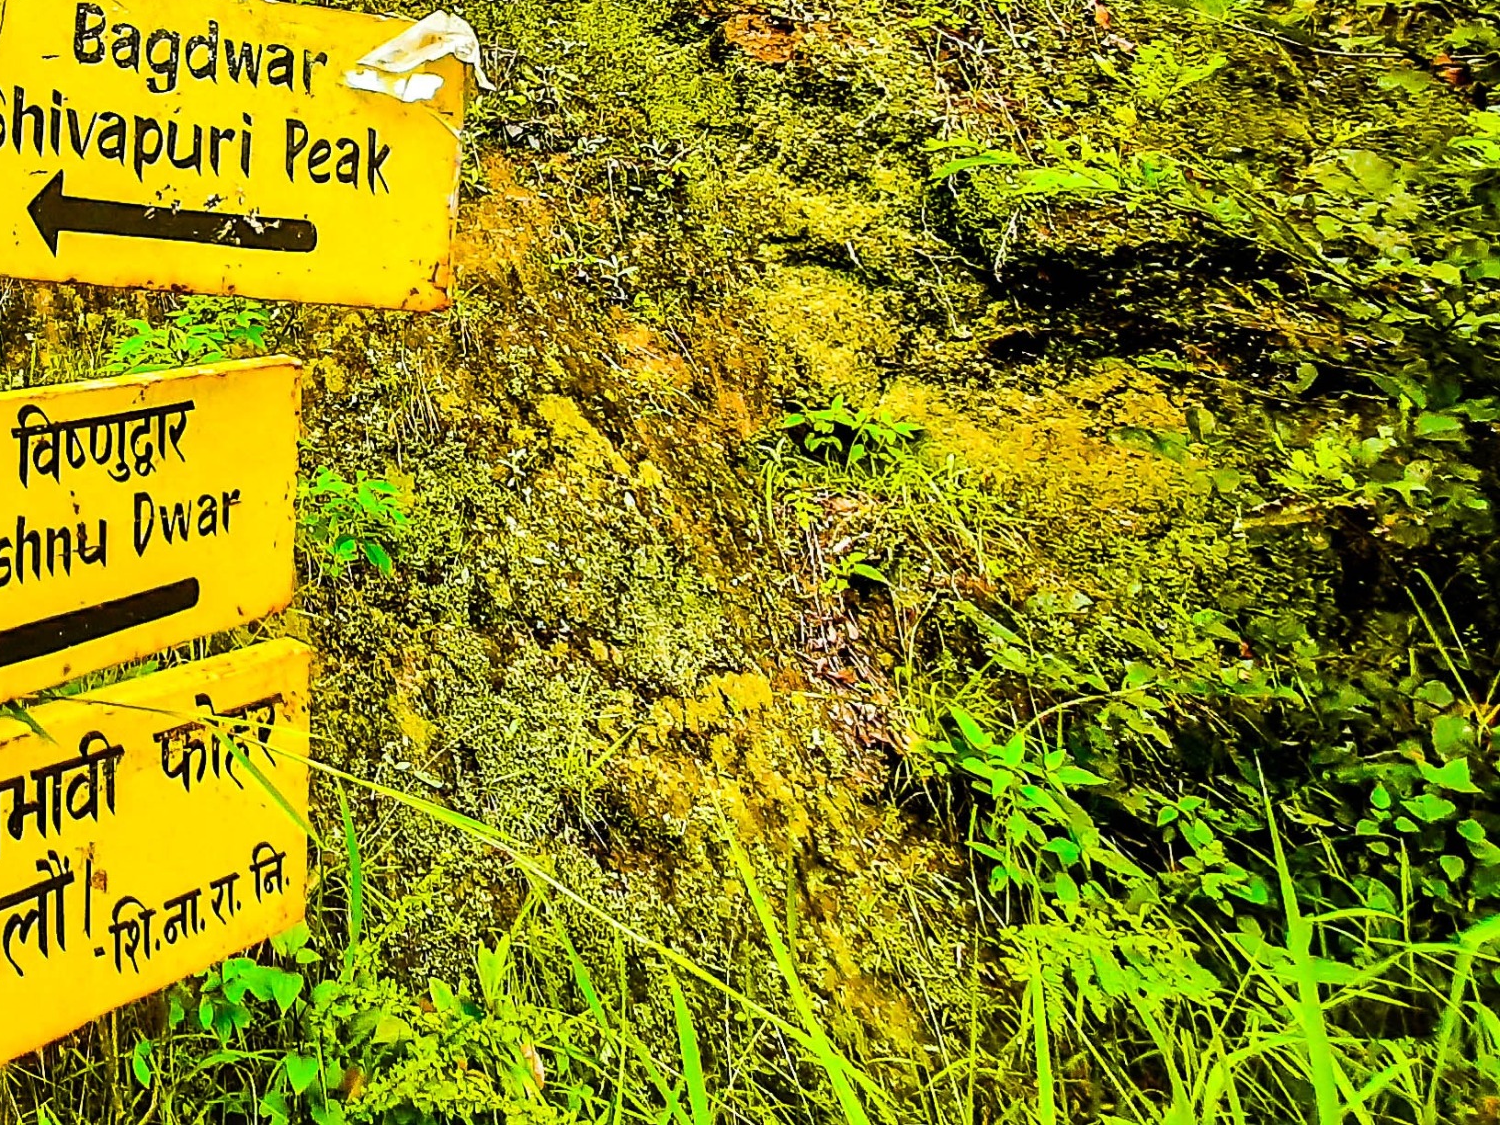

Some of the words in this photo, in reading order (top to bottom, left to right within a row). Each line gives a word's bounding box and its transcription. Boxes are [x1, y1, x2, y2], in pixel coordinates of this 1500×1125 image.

[72, 1, 328, 95] Bagdwar
[284, 117, 394, 195] Peak
[10, 400, 196, 490] विष्णुद्वार
[132, 487, 243, 558] Dwar
